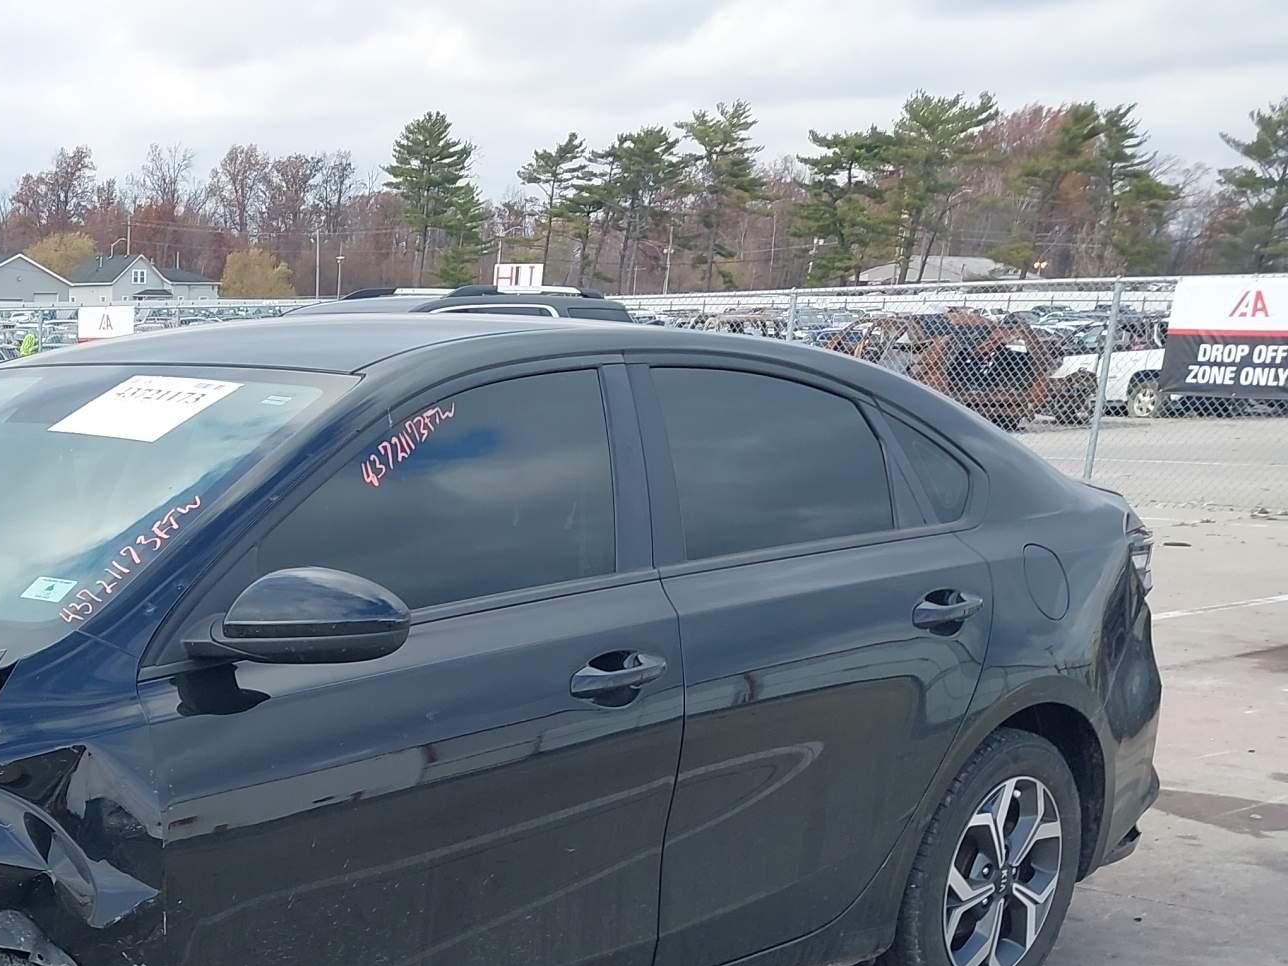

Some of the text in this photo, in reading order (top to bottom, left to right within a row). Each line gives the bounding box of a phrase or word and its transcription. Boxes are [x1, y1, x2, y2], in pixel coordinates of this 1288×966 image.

[1197, 343, 1288, 364] DROP OFF
[1185, 365, 1288, 387] ZONE ONLY
